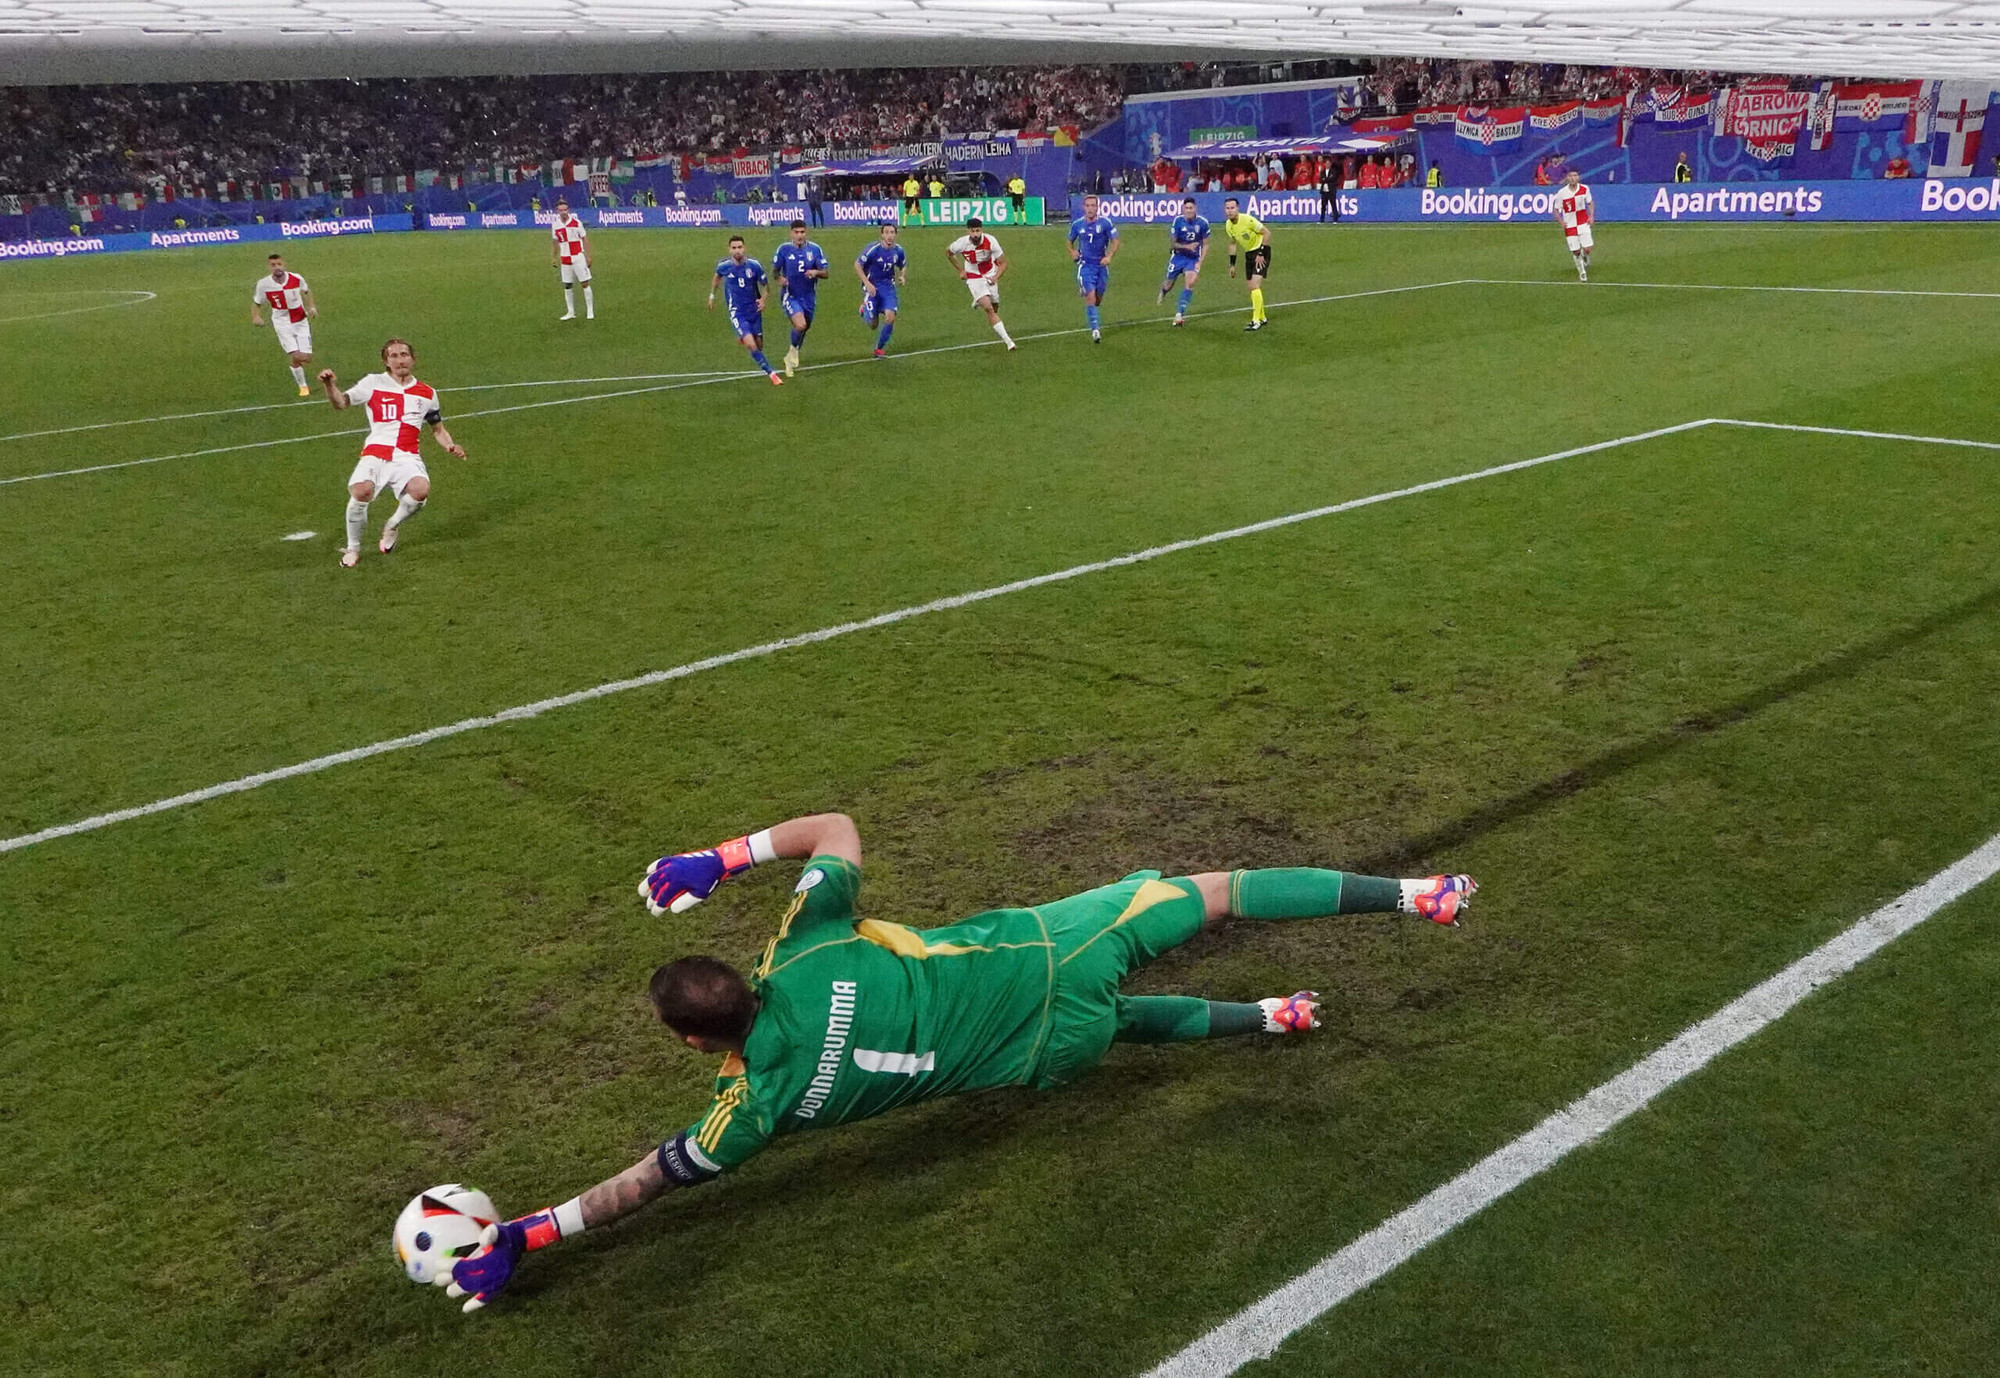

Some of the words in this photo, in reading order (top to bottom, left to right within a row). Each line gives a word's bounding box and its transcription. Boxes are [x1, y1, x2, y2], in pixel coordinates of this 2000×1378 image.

[734, 159, 769, 176] URBACH
[1097, 194, 1185, 223] ooking.co
[1651, 187, 1823, 218] Apartments
[429, 213, 466, 229] Booking.com
[481, 212, 518, 228] Apartments
[599, 210, 644, 226] Apartments
[665, 206, 721, 224] Booking.com
[748, 206, 805, 226] Apartments
[929, 201, 1008, 223] LEIPZIG
[280, 218, 373, 236] Booking.com
[151, 229, 240, 248] Apartments
[1088, 233, 1094, 243] 7
[798, 260, 805, 272] 2
[738, 278, 745, 288] 8
[381, 404, 397, 420] 10
[796, 980, 857, 1120] DONNARUMMA
[853, 1048, 935, 1078] 1
